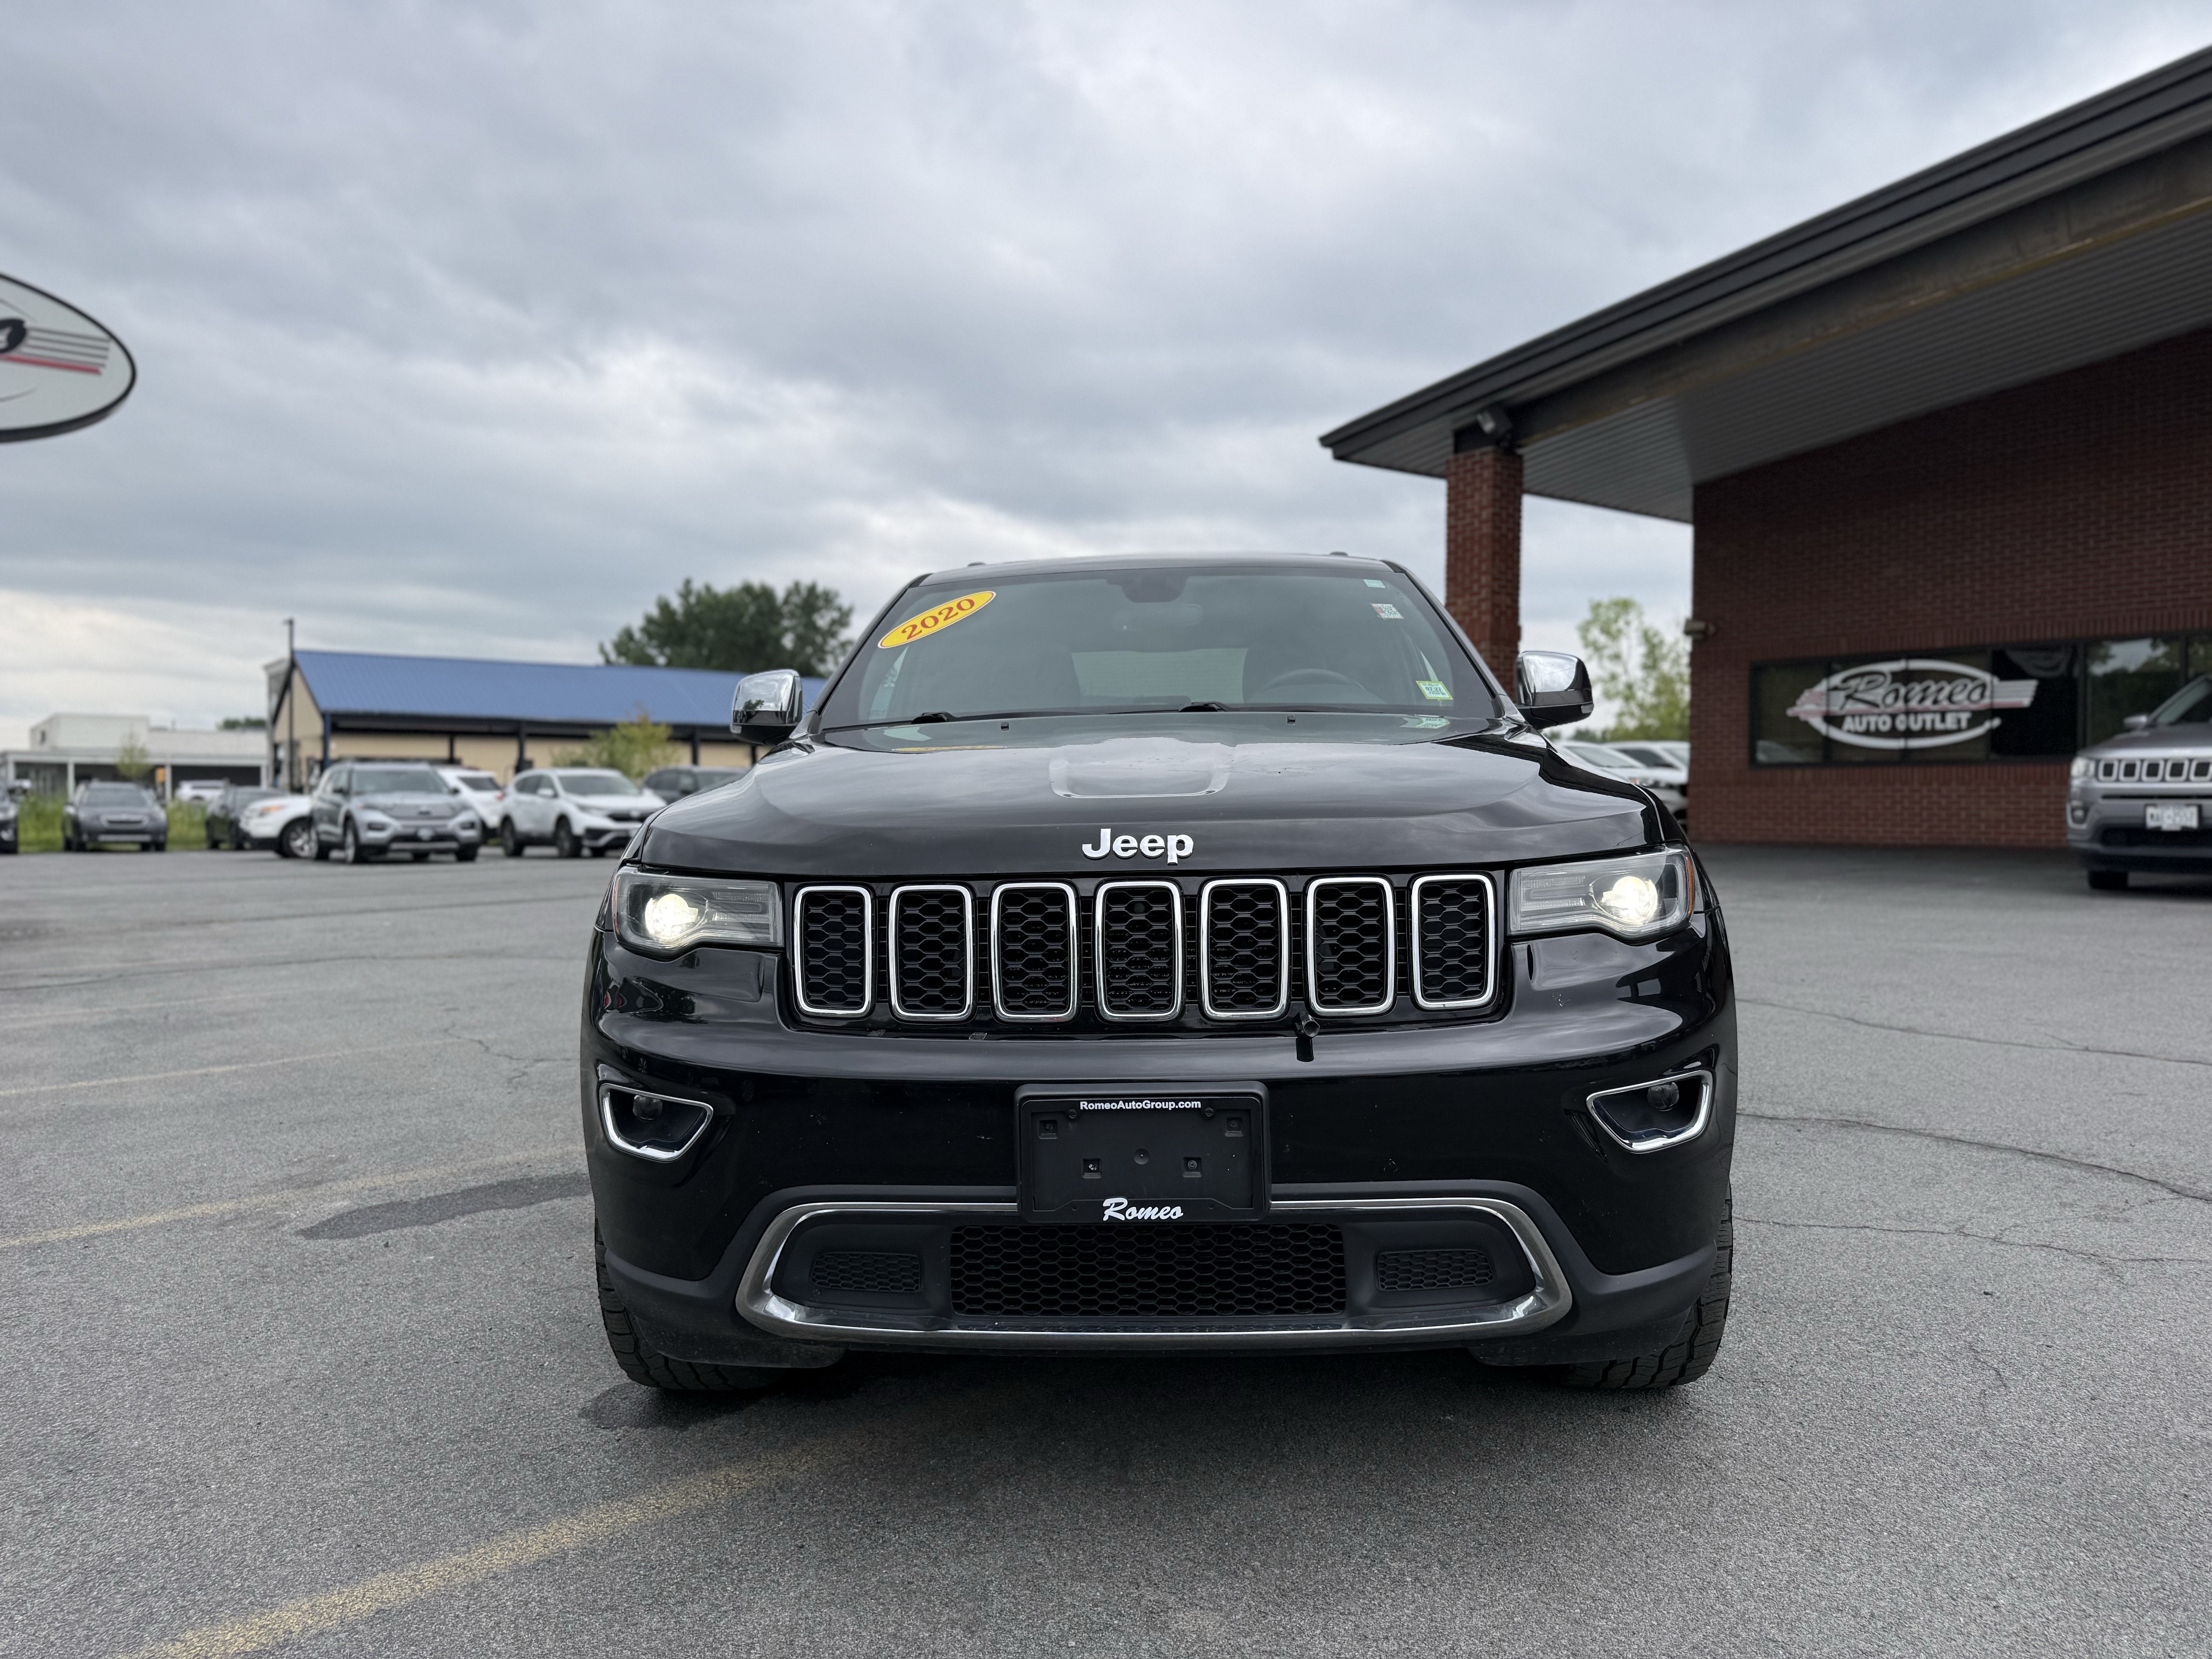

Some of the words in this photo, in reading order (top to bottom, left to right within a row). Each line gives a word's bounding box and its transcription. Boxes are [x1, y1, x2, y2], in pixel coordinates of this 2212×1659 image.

[902, 599, 975, 640] 2020
[1829, 671, 1987, 711] Romeo
[1843, 714, 1892, 732] AUTO
[1895, 711, 1972, 731] OUTLET
[1082, 828, 1194, 866] Jeep
[1080, 1100, 1201, 1111] RomeoAutoGroup.com
[1102, 1197, 1183, 1221] Romeo
